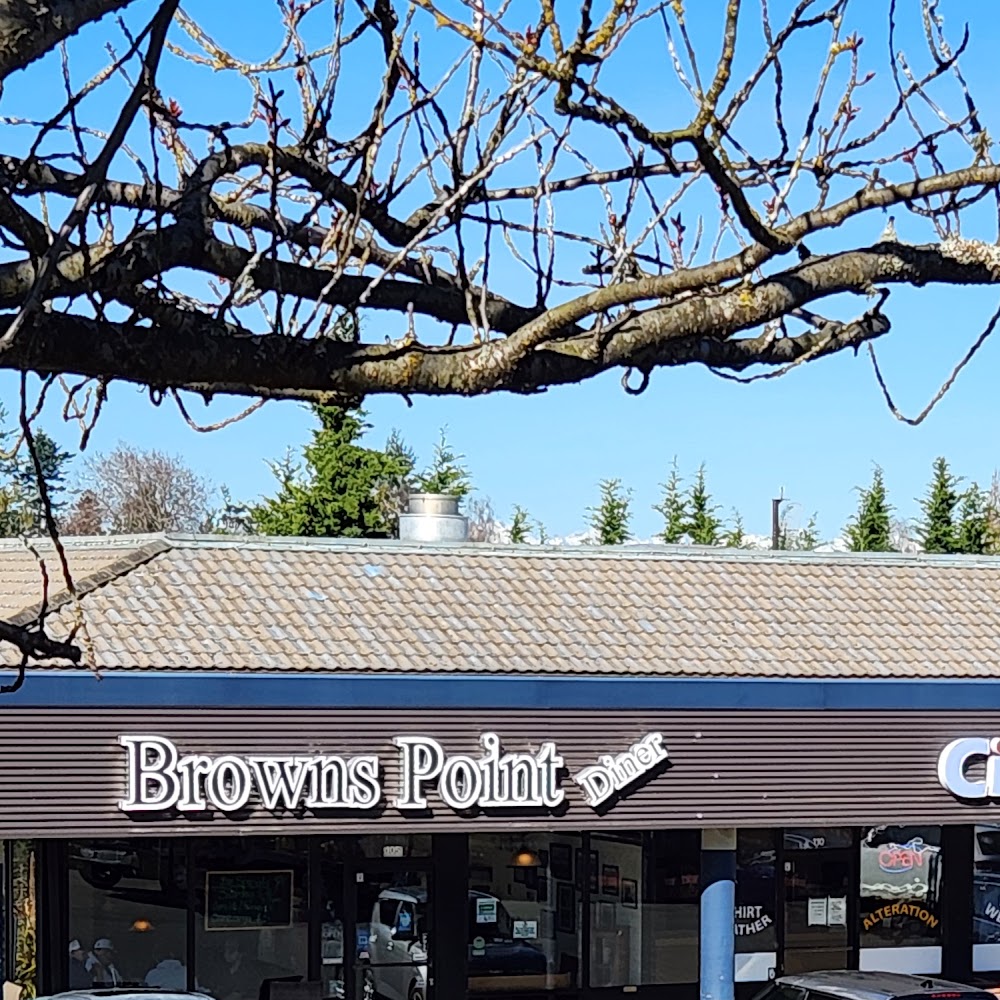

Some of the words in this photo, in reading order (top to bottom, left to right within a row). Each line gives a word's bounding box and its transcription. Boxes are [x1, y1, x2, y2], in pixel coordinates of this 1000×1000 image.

[118, 734, 382, 812] Browns
[393, 731, 565, 810] Point
[573, 731, 669, 807] Diner
[734, 905, 763, 919] HIRT
[862, 903, 939, 930] ALTERATION
[734, 914, 773, 936] THER
